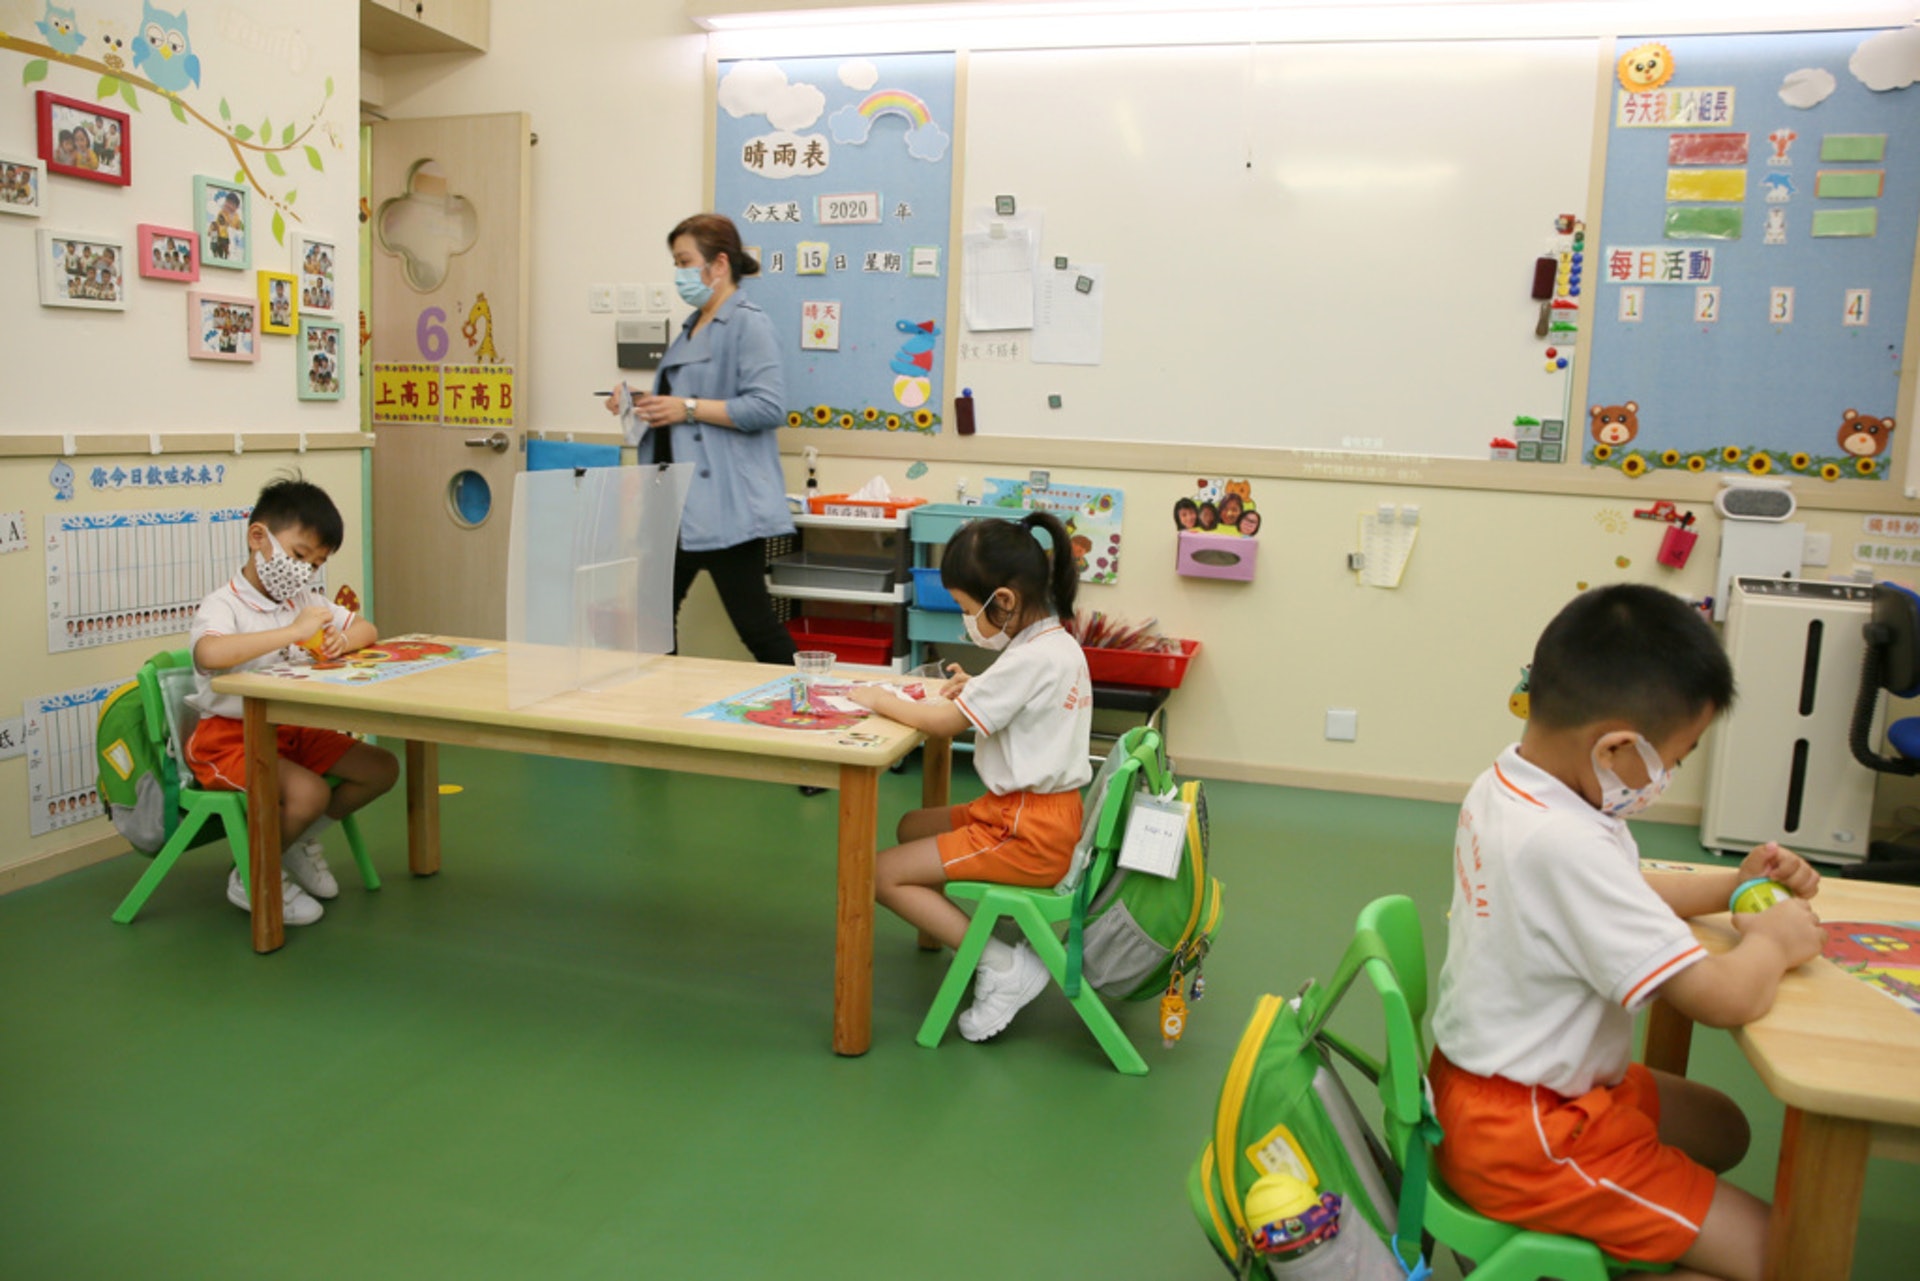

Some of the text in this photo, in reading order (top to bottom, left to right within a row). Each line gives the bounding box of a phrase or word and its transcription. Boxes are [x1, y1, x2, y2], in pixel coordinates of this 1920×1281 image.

[743, 140, 827, 169] 晴雨表
[745, 200, 913, 224] 今天是 2020 年
[771, 253, 784, 272] 月
[803, 250, 822, 269] 15
[834, 254, 847, 270] 日
[863, 252, 901, 272] 星期
[1608, 249, 1712, 281] 每日活動
[1625, 292, 1863, 321] 1 2 3 4
[416, 306, 449, 362] 6
